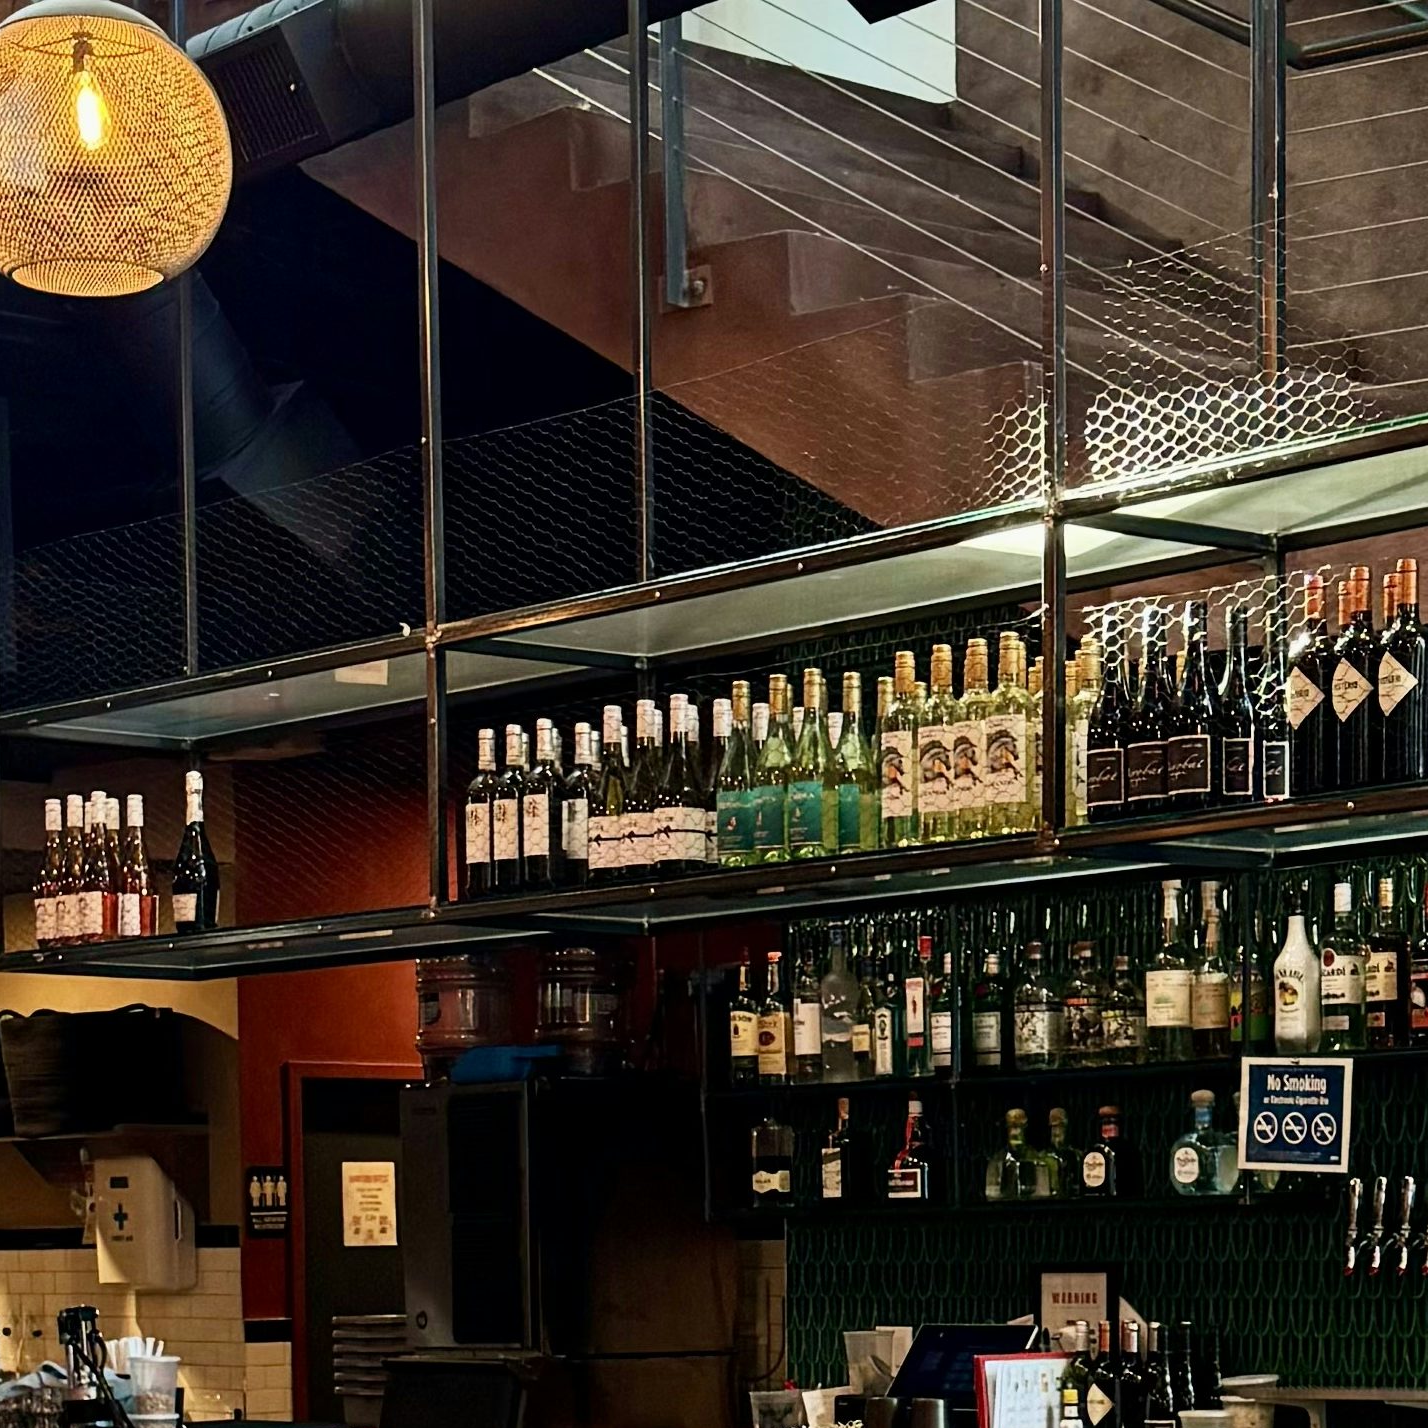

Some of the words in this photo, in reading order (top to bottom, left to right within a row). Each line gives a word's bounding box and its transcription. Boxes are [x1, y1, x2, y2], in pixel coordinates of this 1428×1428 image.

[1267, 1074, 1281, 1091] No
[1283, 1073, 1327, 1095] Smoking
[1051, 1292, 1098, 1304] WARNING
